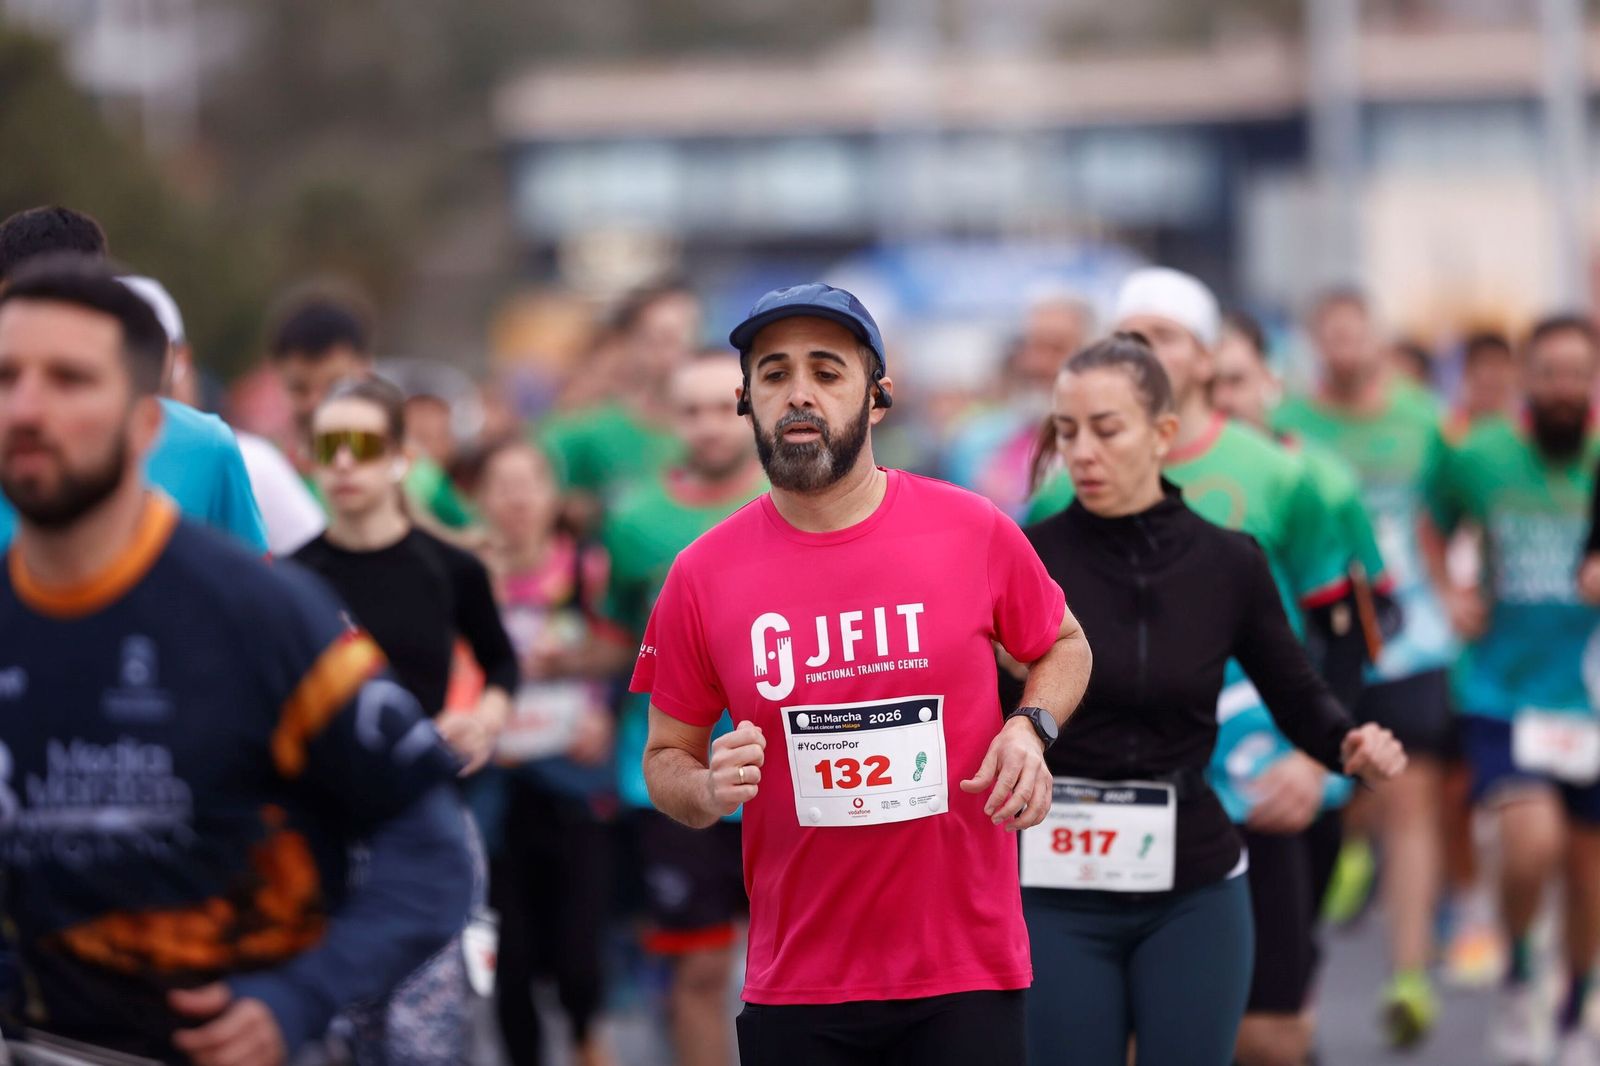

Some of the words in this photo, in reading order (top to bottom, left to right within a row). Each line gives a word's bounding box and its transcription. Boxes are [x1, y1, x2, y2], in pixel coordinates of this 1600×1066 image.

[805, 602, 924, 667] JFIT
[805, 669, 855, 683] FUNCTIONAL
[857, 661, 895, 675] TRAINING
[898, 658, 929, 669] CENTER
[811, 714, 822, 724] En
[824, 712, 862, 723] Marcha
[869, 709, 902, 724] 2026
[797, 740, 859, 751] #YoCorroPor
[815, 755, 893, 790] 132
[1052, 827, 1117, 855] 817
